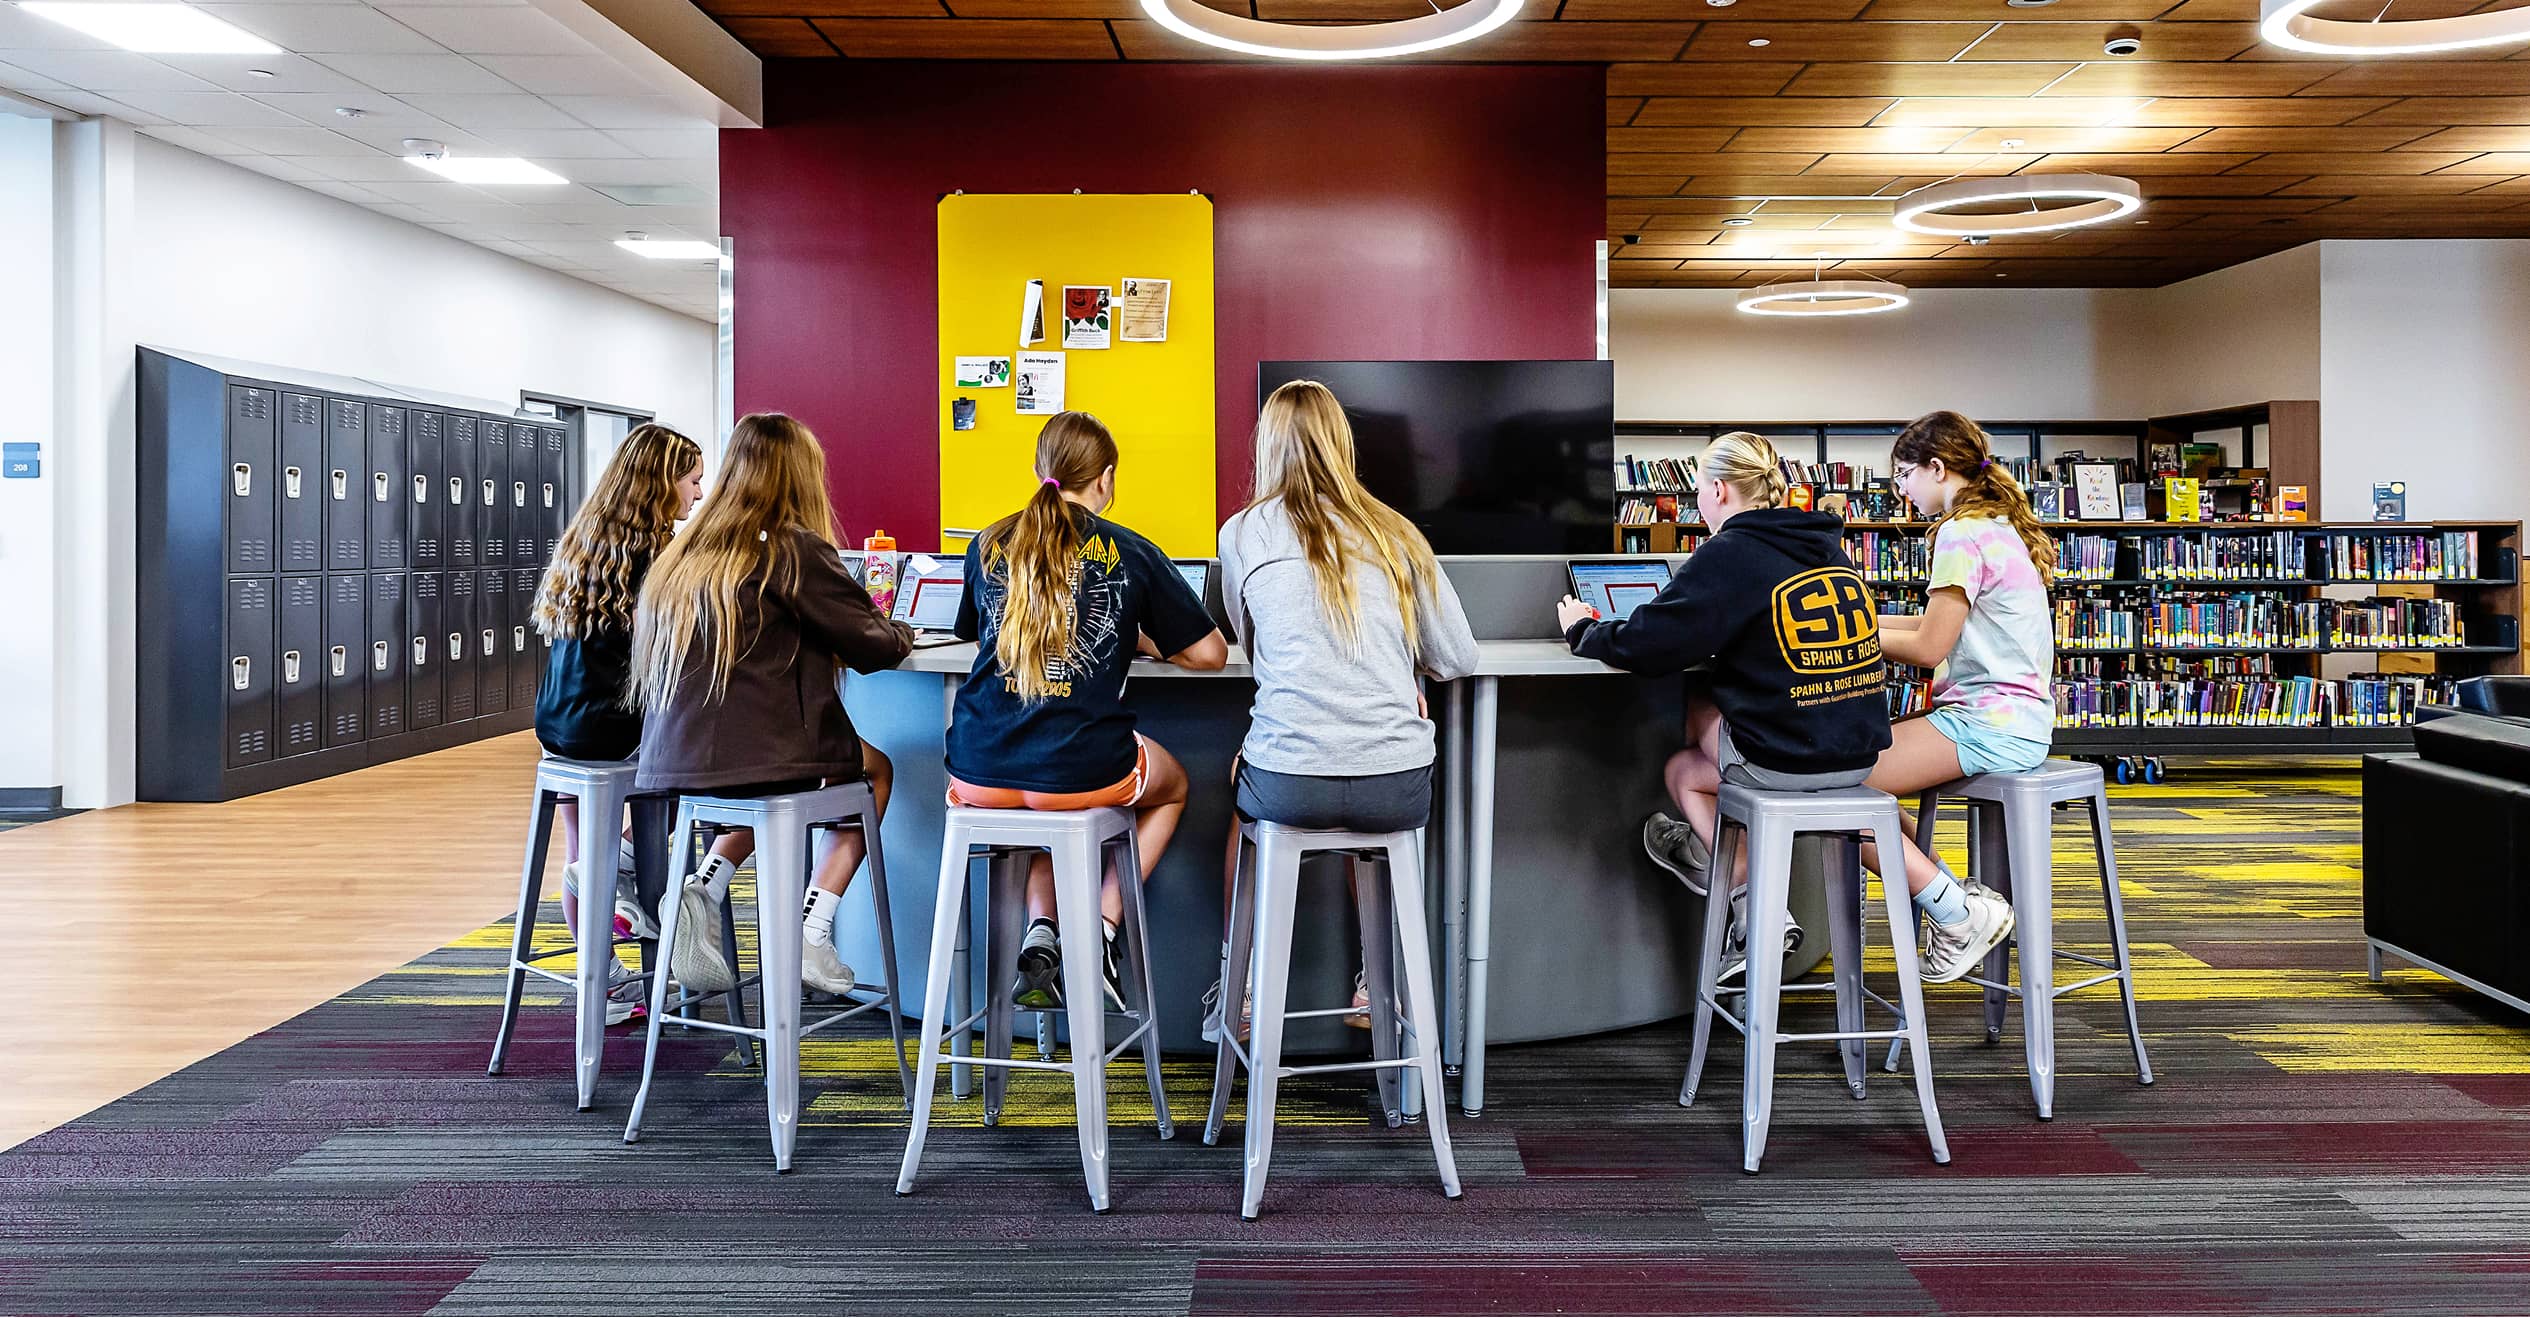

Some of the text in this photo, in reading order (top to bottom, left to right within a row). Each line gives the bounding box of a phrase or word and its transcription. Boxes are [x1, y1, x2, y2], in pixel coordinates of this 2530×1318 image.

[1800, 649, 1843, 666] SPAHN
[1790, 682, 1823, 699] SPAHN
[1825, 680, 1833, 693] &
[1834, 676, 1853, 692] ROSE
